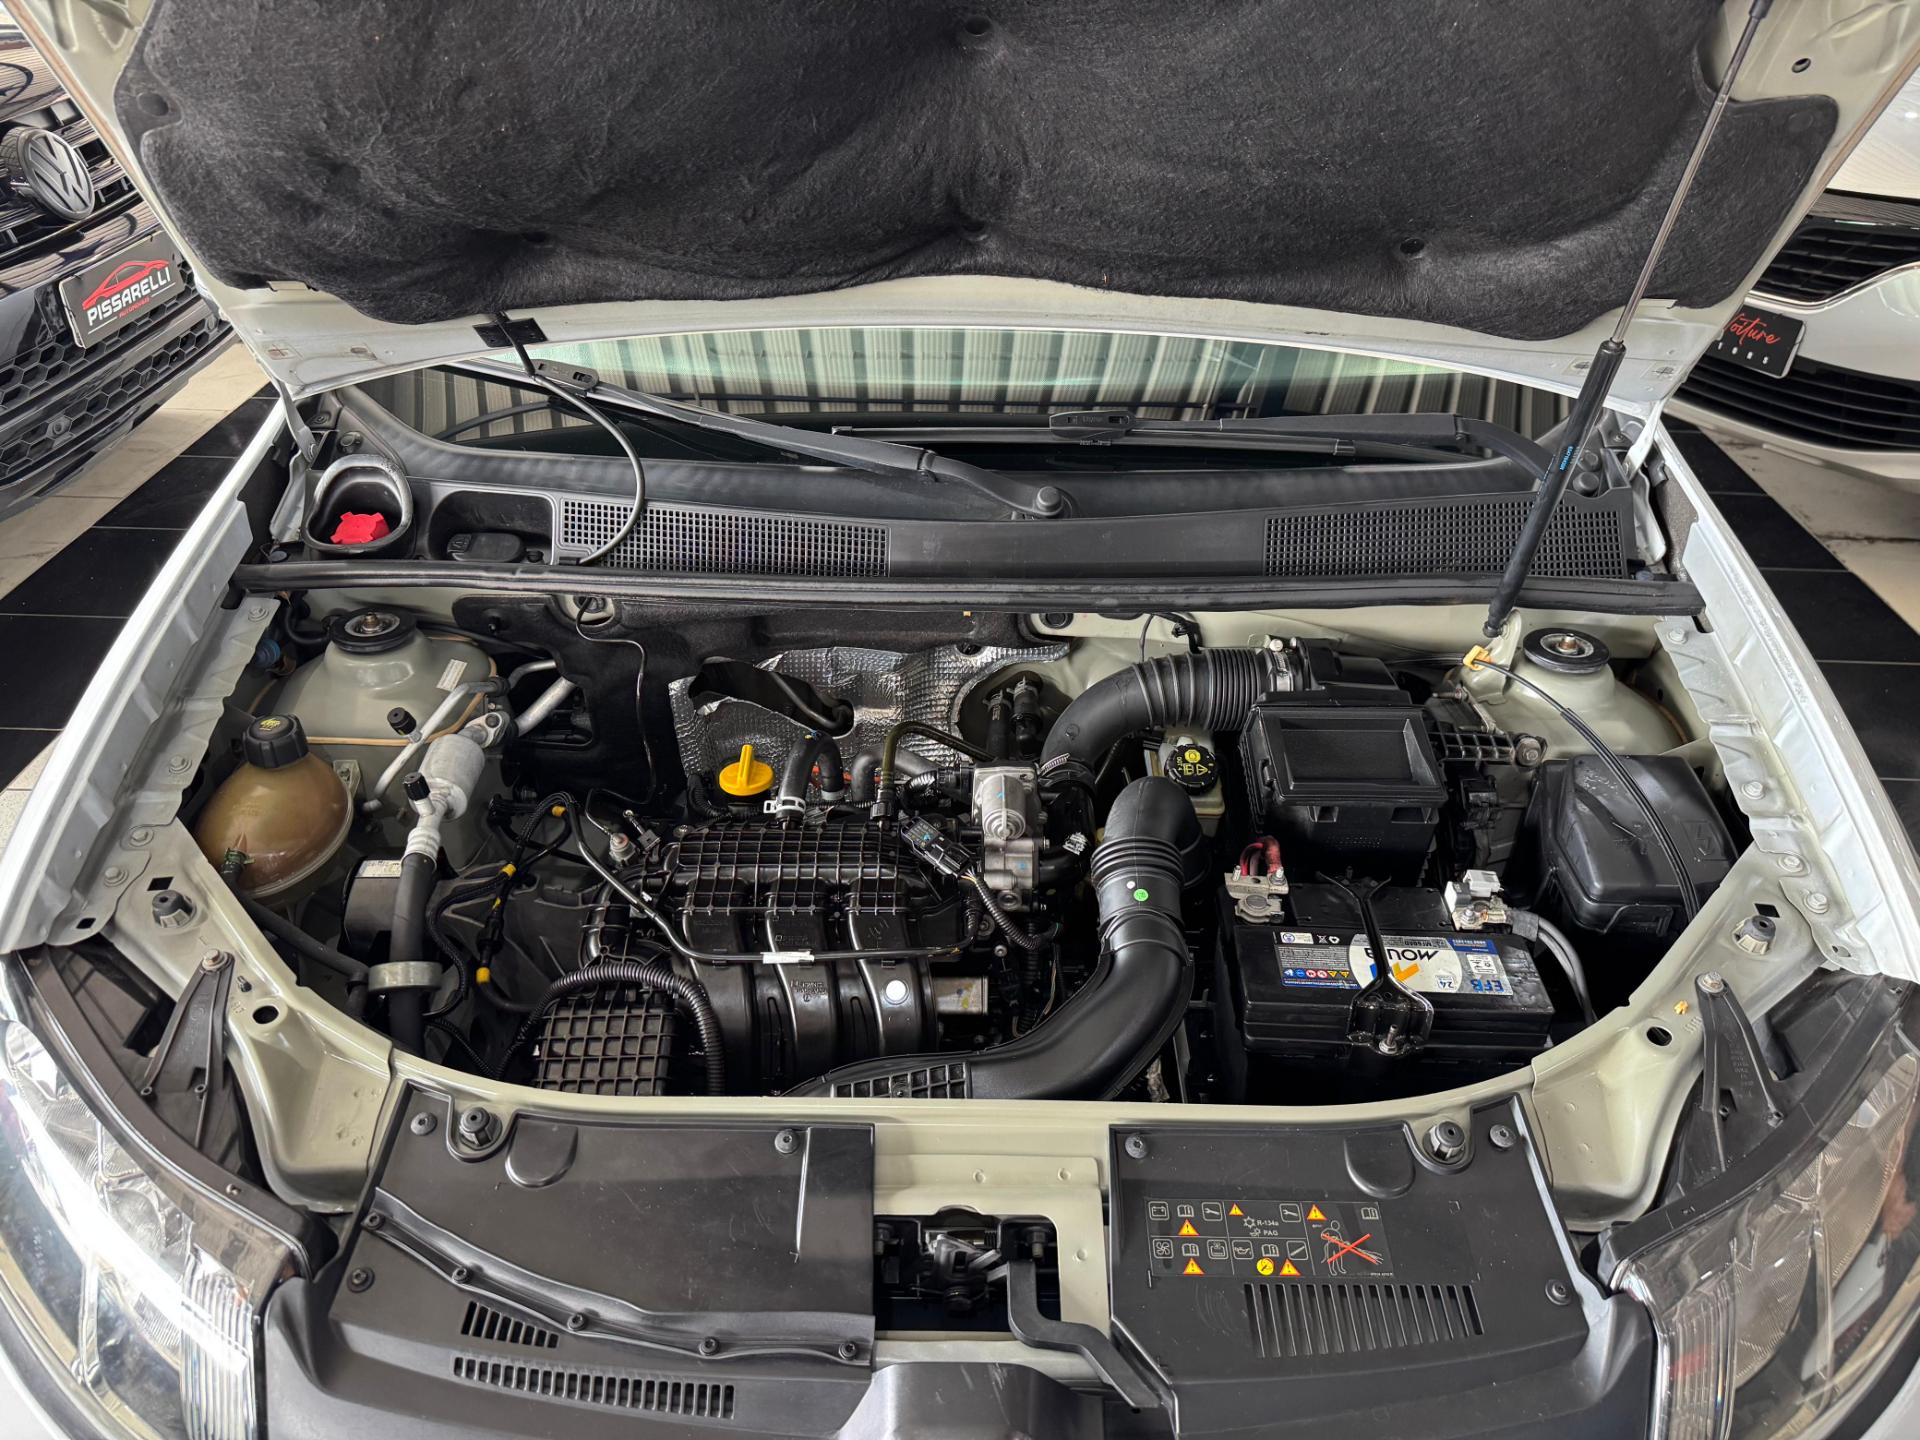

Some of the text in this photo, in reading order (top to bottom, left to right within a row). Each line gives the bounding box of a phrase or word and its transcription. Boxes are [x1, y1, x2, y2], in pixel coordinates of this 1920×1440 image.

[86, 266, 171, 327] PISSARELLI
[1470, 979, 1505, 993] EFB
[1256, 1219, 1280, 1227] R-134a
